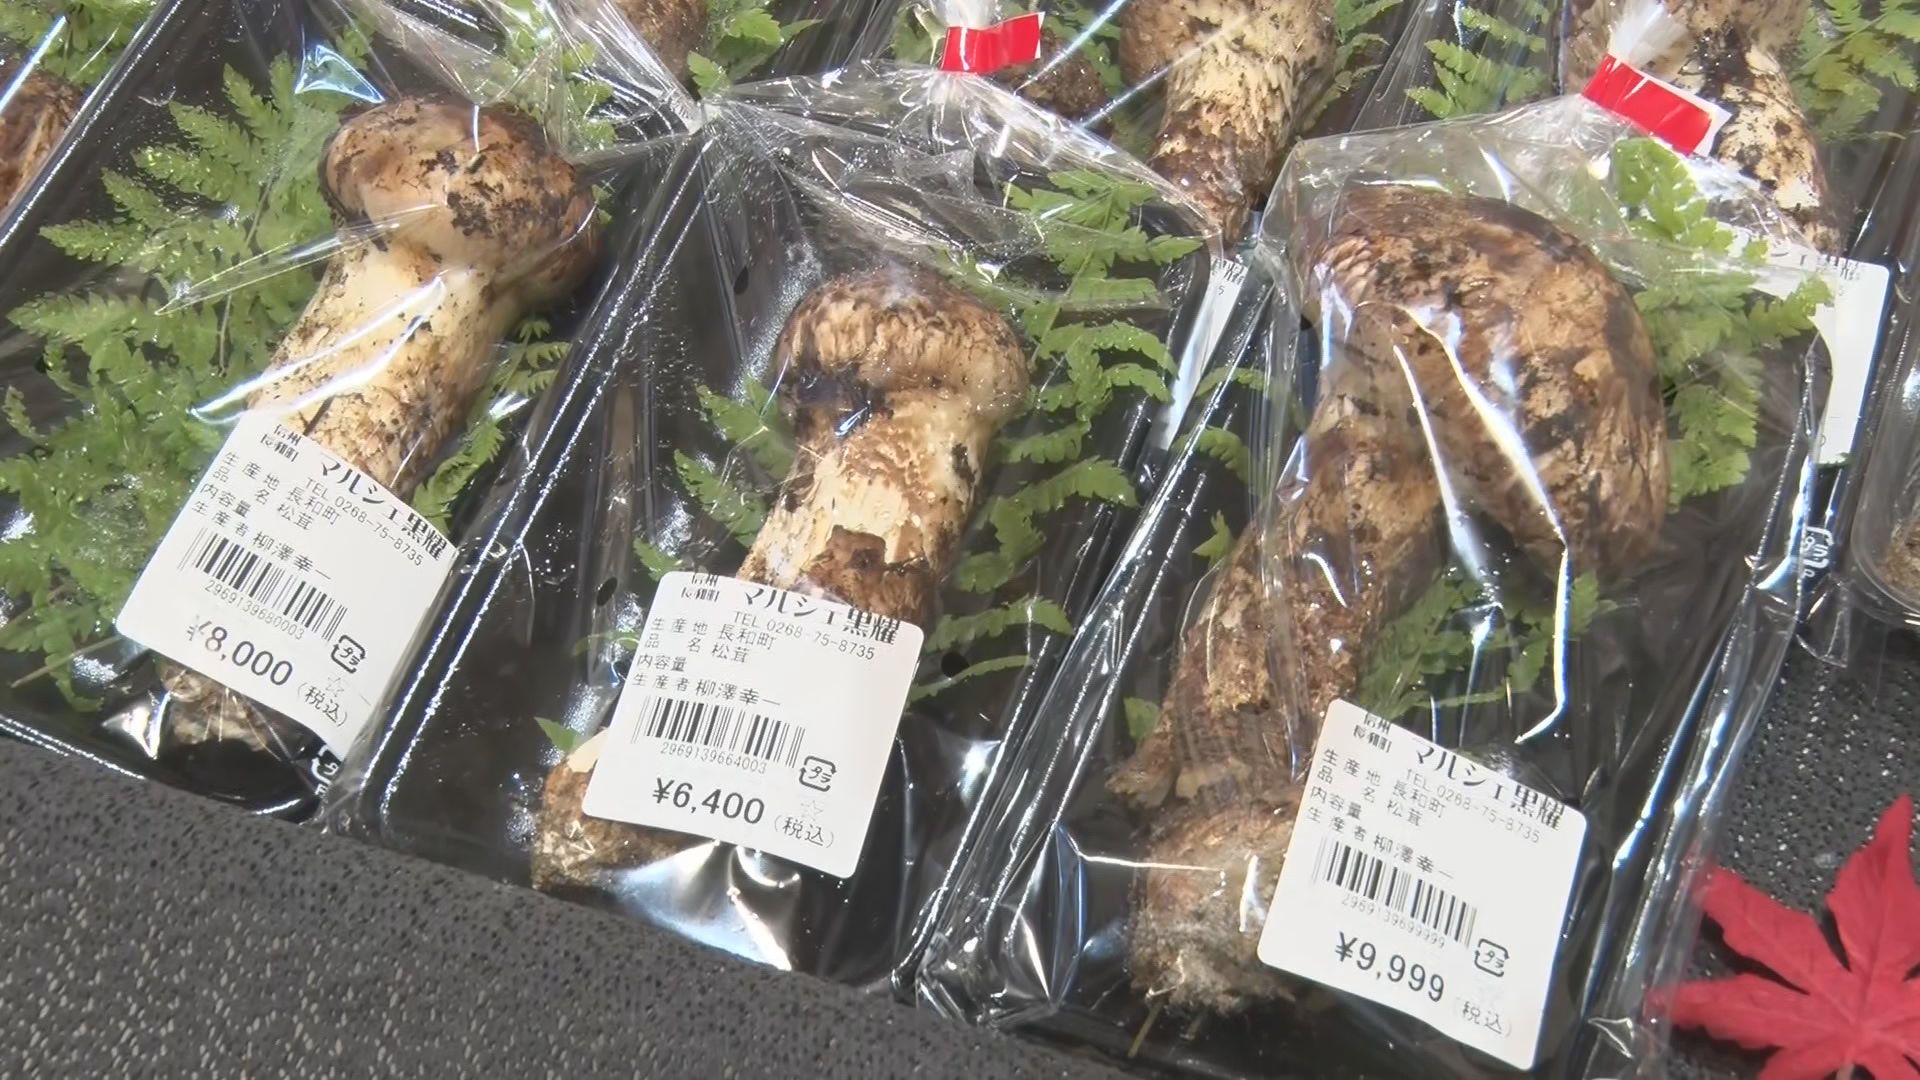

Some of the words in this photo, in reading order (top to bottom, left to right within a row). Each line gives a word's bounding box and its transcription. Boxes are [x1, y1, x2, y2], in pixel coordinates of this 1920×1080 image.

[200, 483, 251, 518] 内容量
[224, 451, 280, 491] 生産地
[288, 486, 341, 526] 長和町
[277, 501, 315, 531] 松茸
[304, 477, 329, 499] TEL
[335, 496, 425, 567] 0268-75-8735
[252, 530, 331, 580] 柳澤幸一
[651, 617, 708, 637] 生産地
[718, 624, 777, 652] 長和町
[733, 611, 758, 629] TEL
[638, 653, 687, 672] 内容量
[712, 641, 749, 663] 松茸
[298, 682, 348, 727] (税込)
[695, 679, 781, 707] 柳澤幸一
[660, 741, 767, 774] 2969139664003
[652, 777, 765, 824] ¥6,400
[1323, 748, 1381, 787] 生産地
[1392, 779, 1446, 819] 長和町
[1310, 786, 1362, 820] 内容量
[1387, 799, 1423, 827] 松茸
[1405, 768, 1434, 792] TEL
[1436, 784, 1540, 844] 0268-75-8735
[774, 814, 835, 849] (税込)
[1373, 833, 1454, 879] 柳澤幸一
[1334, 931, 1445, 1003] ¥9,999
